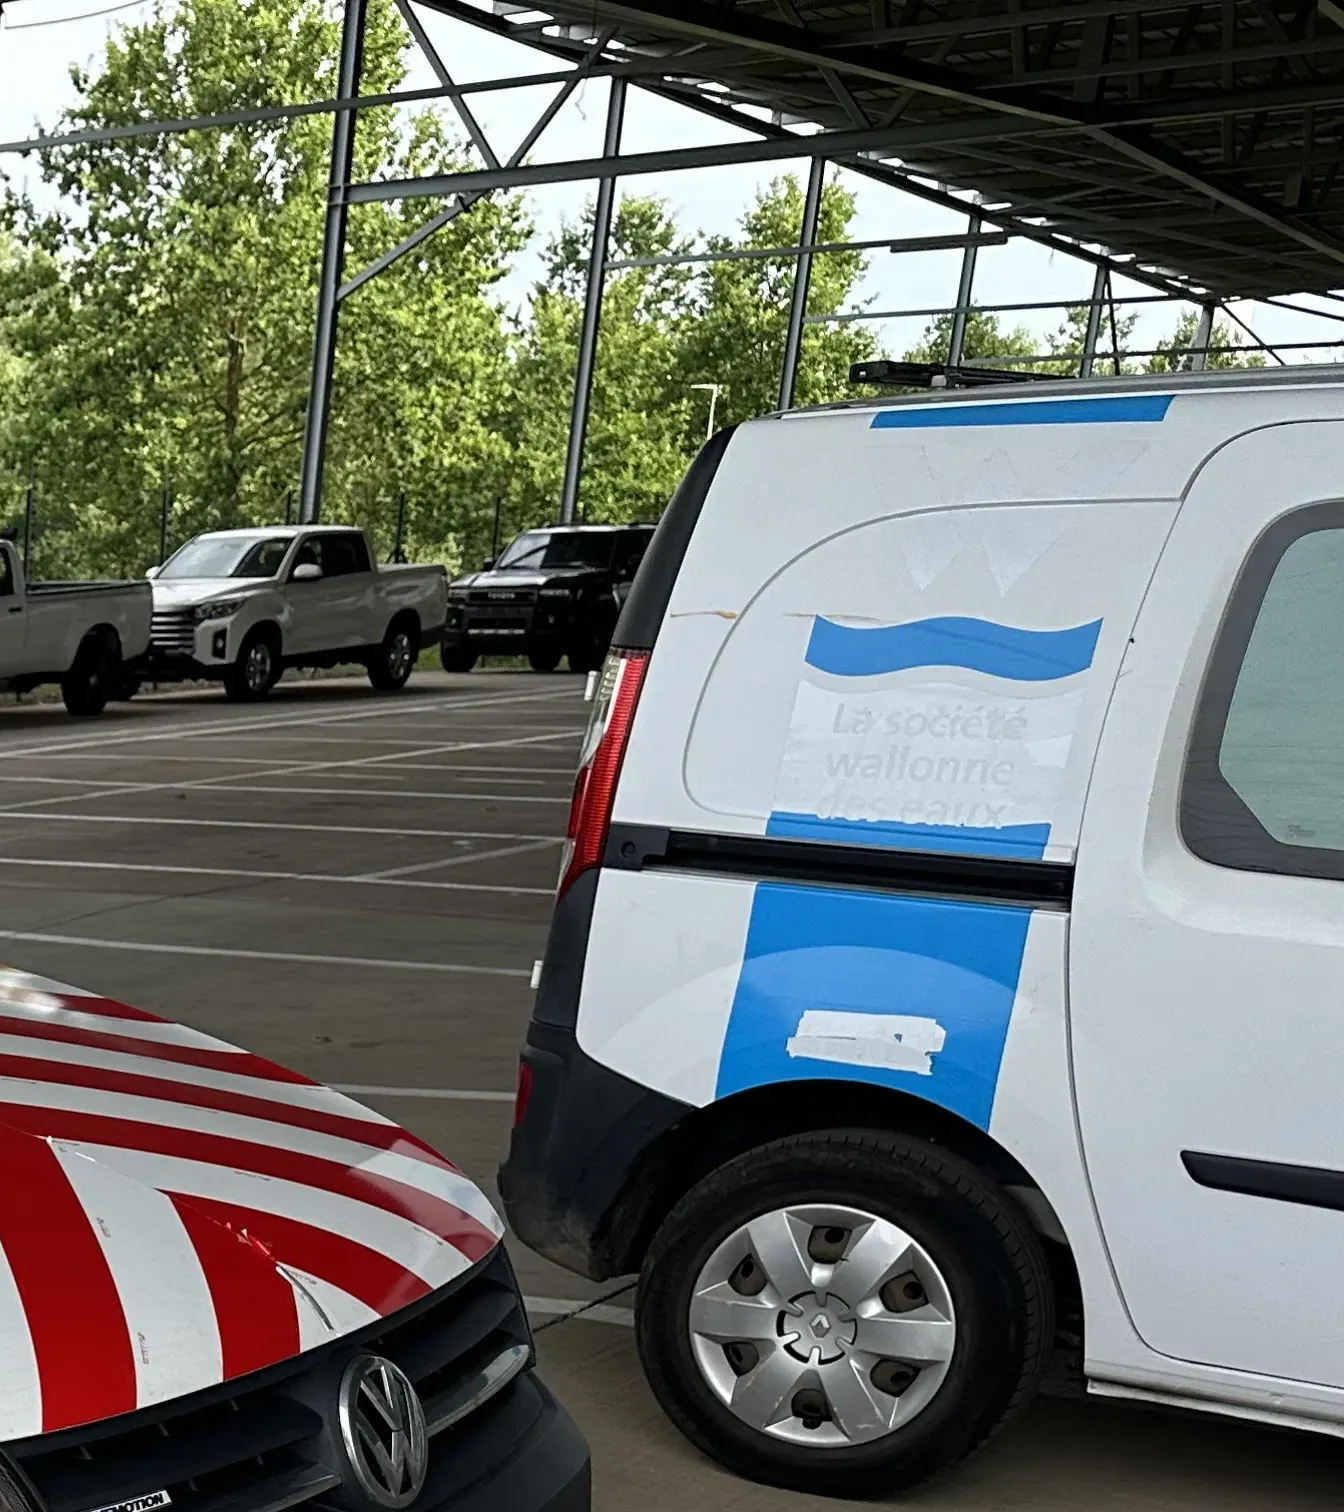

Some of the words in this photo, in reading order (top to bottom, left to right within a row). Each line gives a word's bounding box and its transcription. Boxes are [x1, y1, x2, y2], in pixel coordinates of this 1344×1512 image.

[832, 702, 873, 735] La
[883, 704, 1028, 741] société
[825, 745, 1015, 786] wallonne
[816, 781, 883, 821] des
[900, 797, 1008, 828] eaux
